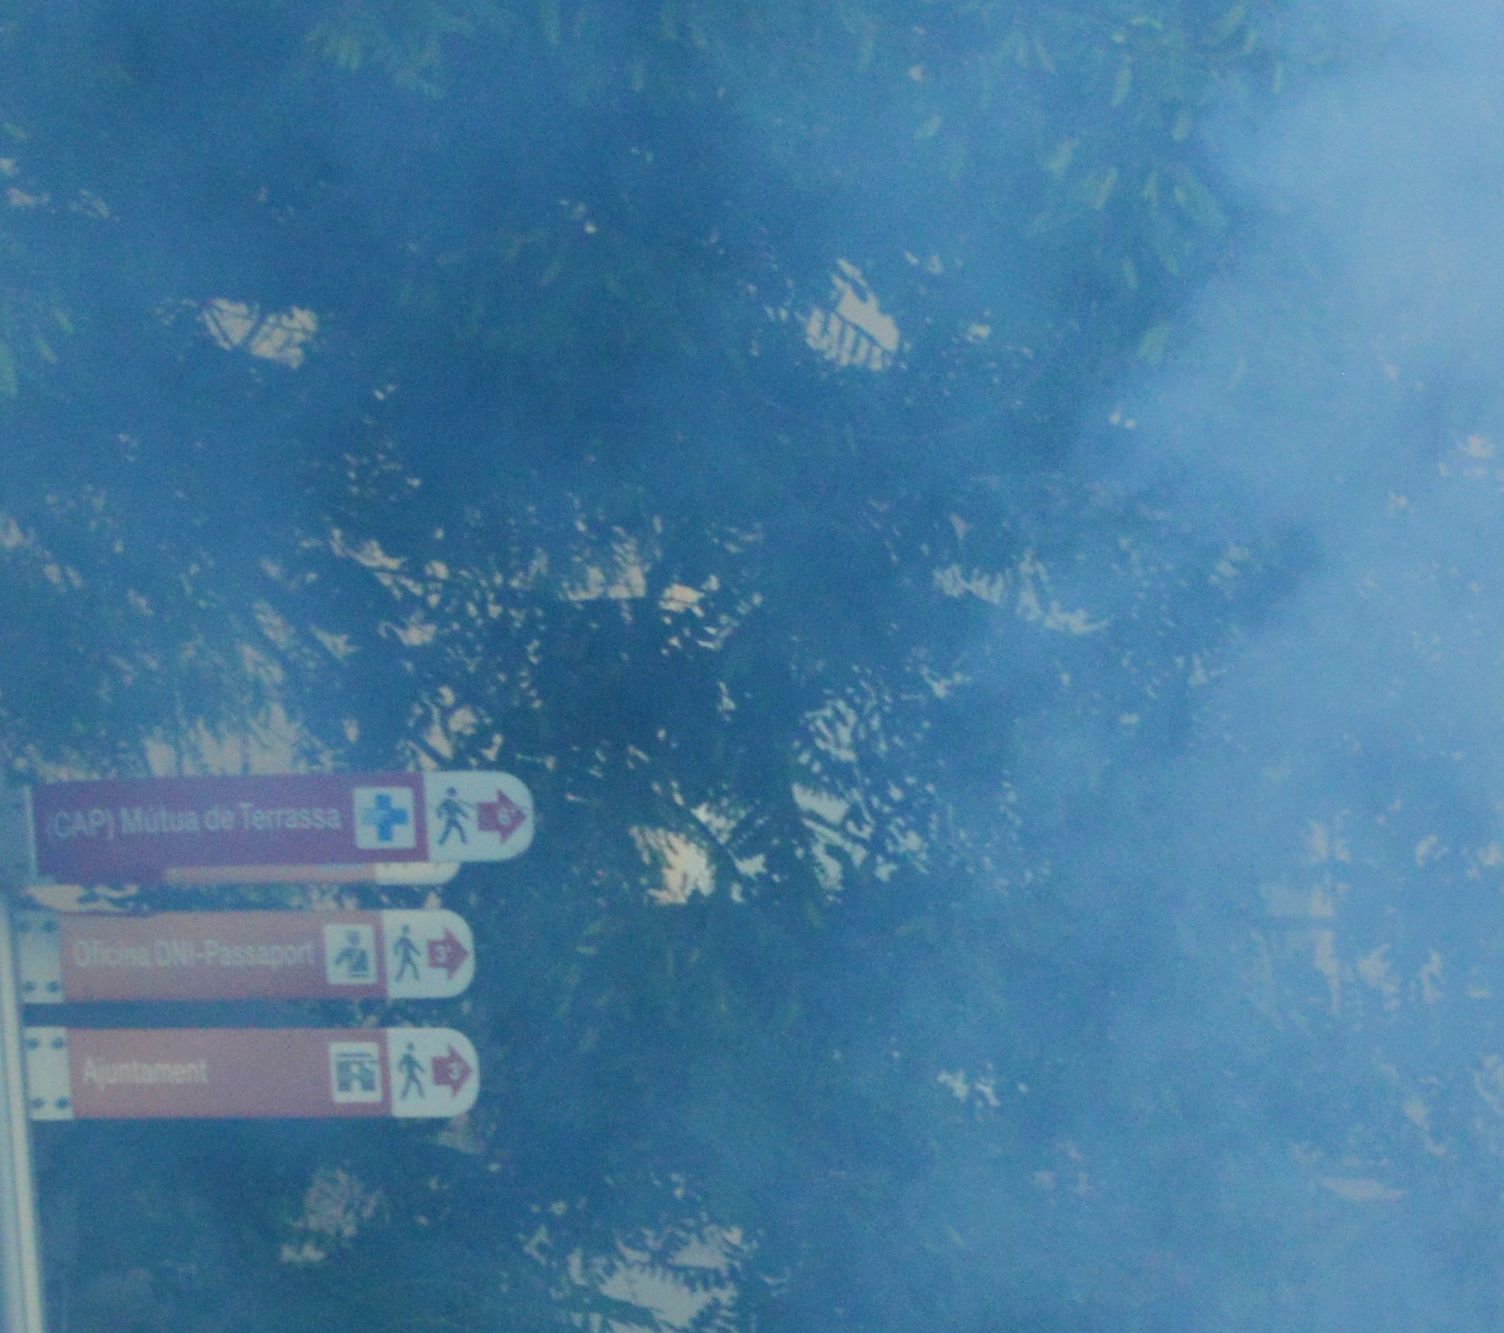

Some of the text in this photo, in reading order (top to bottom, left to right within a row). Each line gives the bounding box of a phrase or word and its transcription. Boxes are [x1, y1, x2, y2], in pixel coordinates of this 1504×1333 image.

[48, 801, 343, 843] (CAP) Mútua de Terrassa
[82, 1056, 209, 1091] Ajuntament
